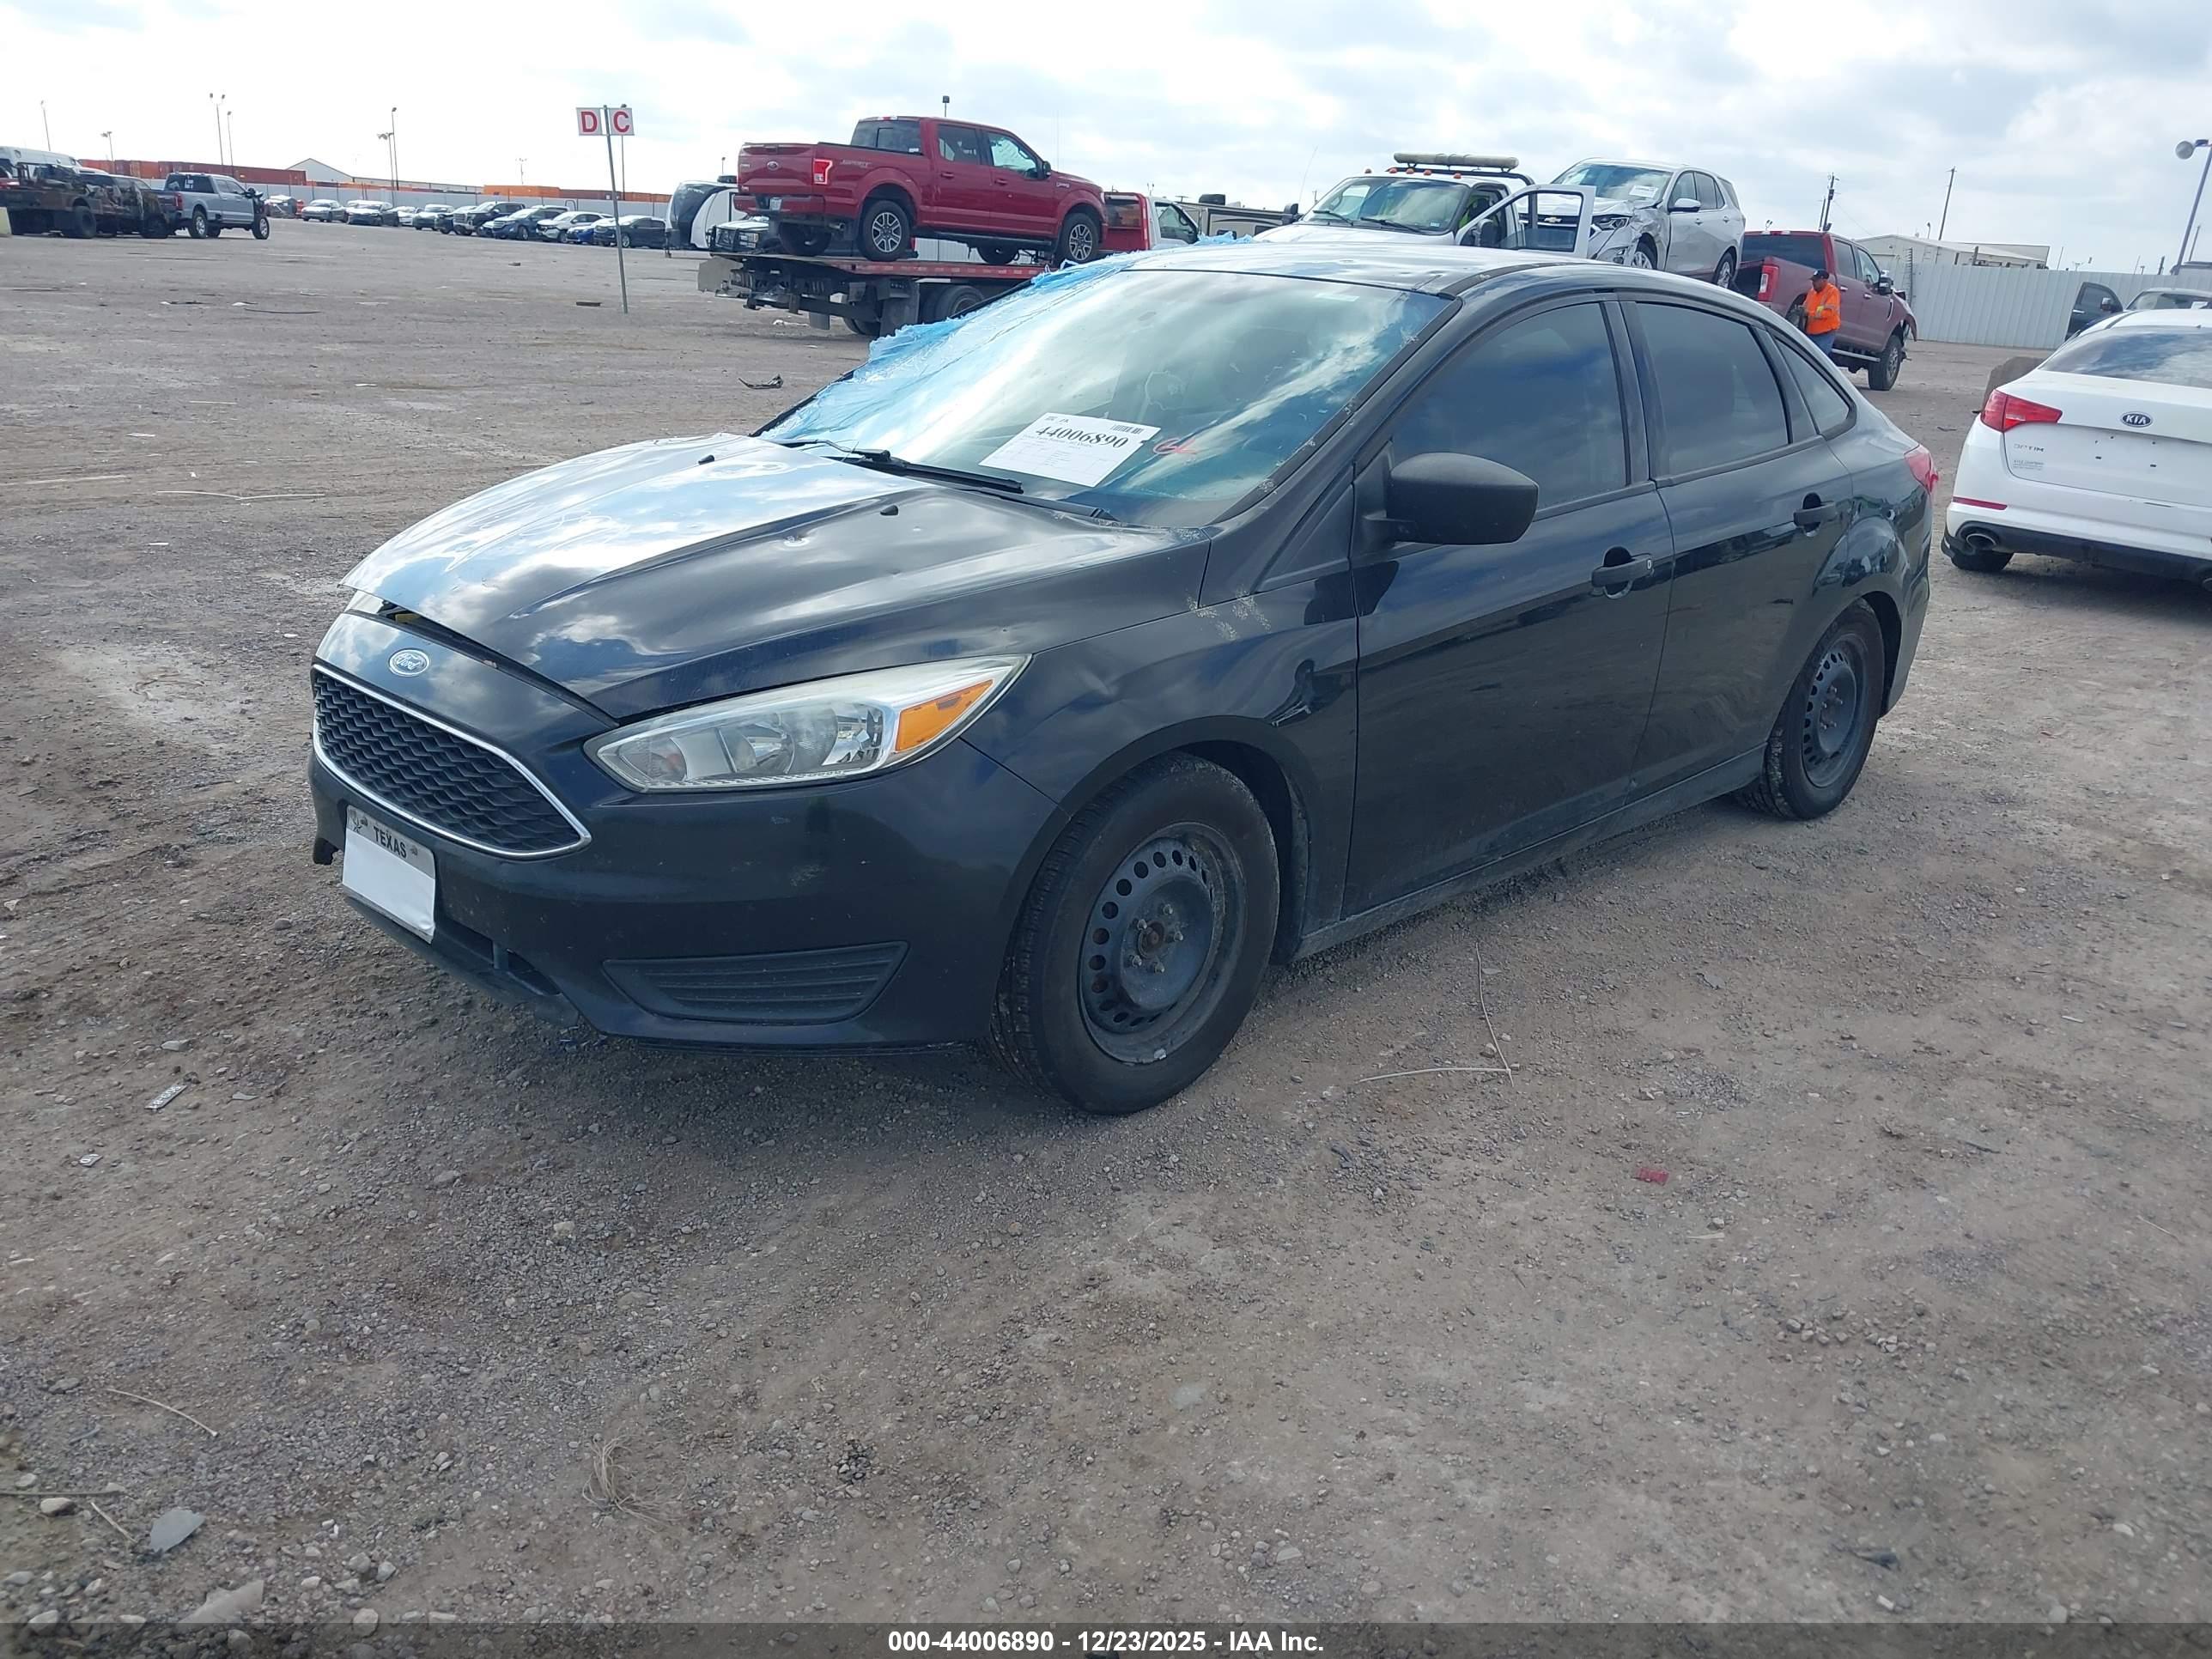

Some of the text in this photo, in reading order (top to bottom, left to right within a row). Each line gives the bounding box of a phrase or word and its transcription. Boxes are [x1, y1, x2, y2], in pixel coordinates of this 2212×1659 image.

[580, 111, 598, 133] D
[613, 111, 630, 133] C
[2126, 414, 2147, 425] KIA
[1036, 425, 1129, 449] 44006890
[374, 826, 407, 859] TEXAS
